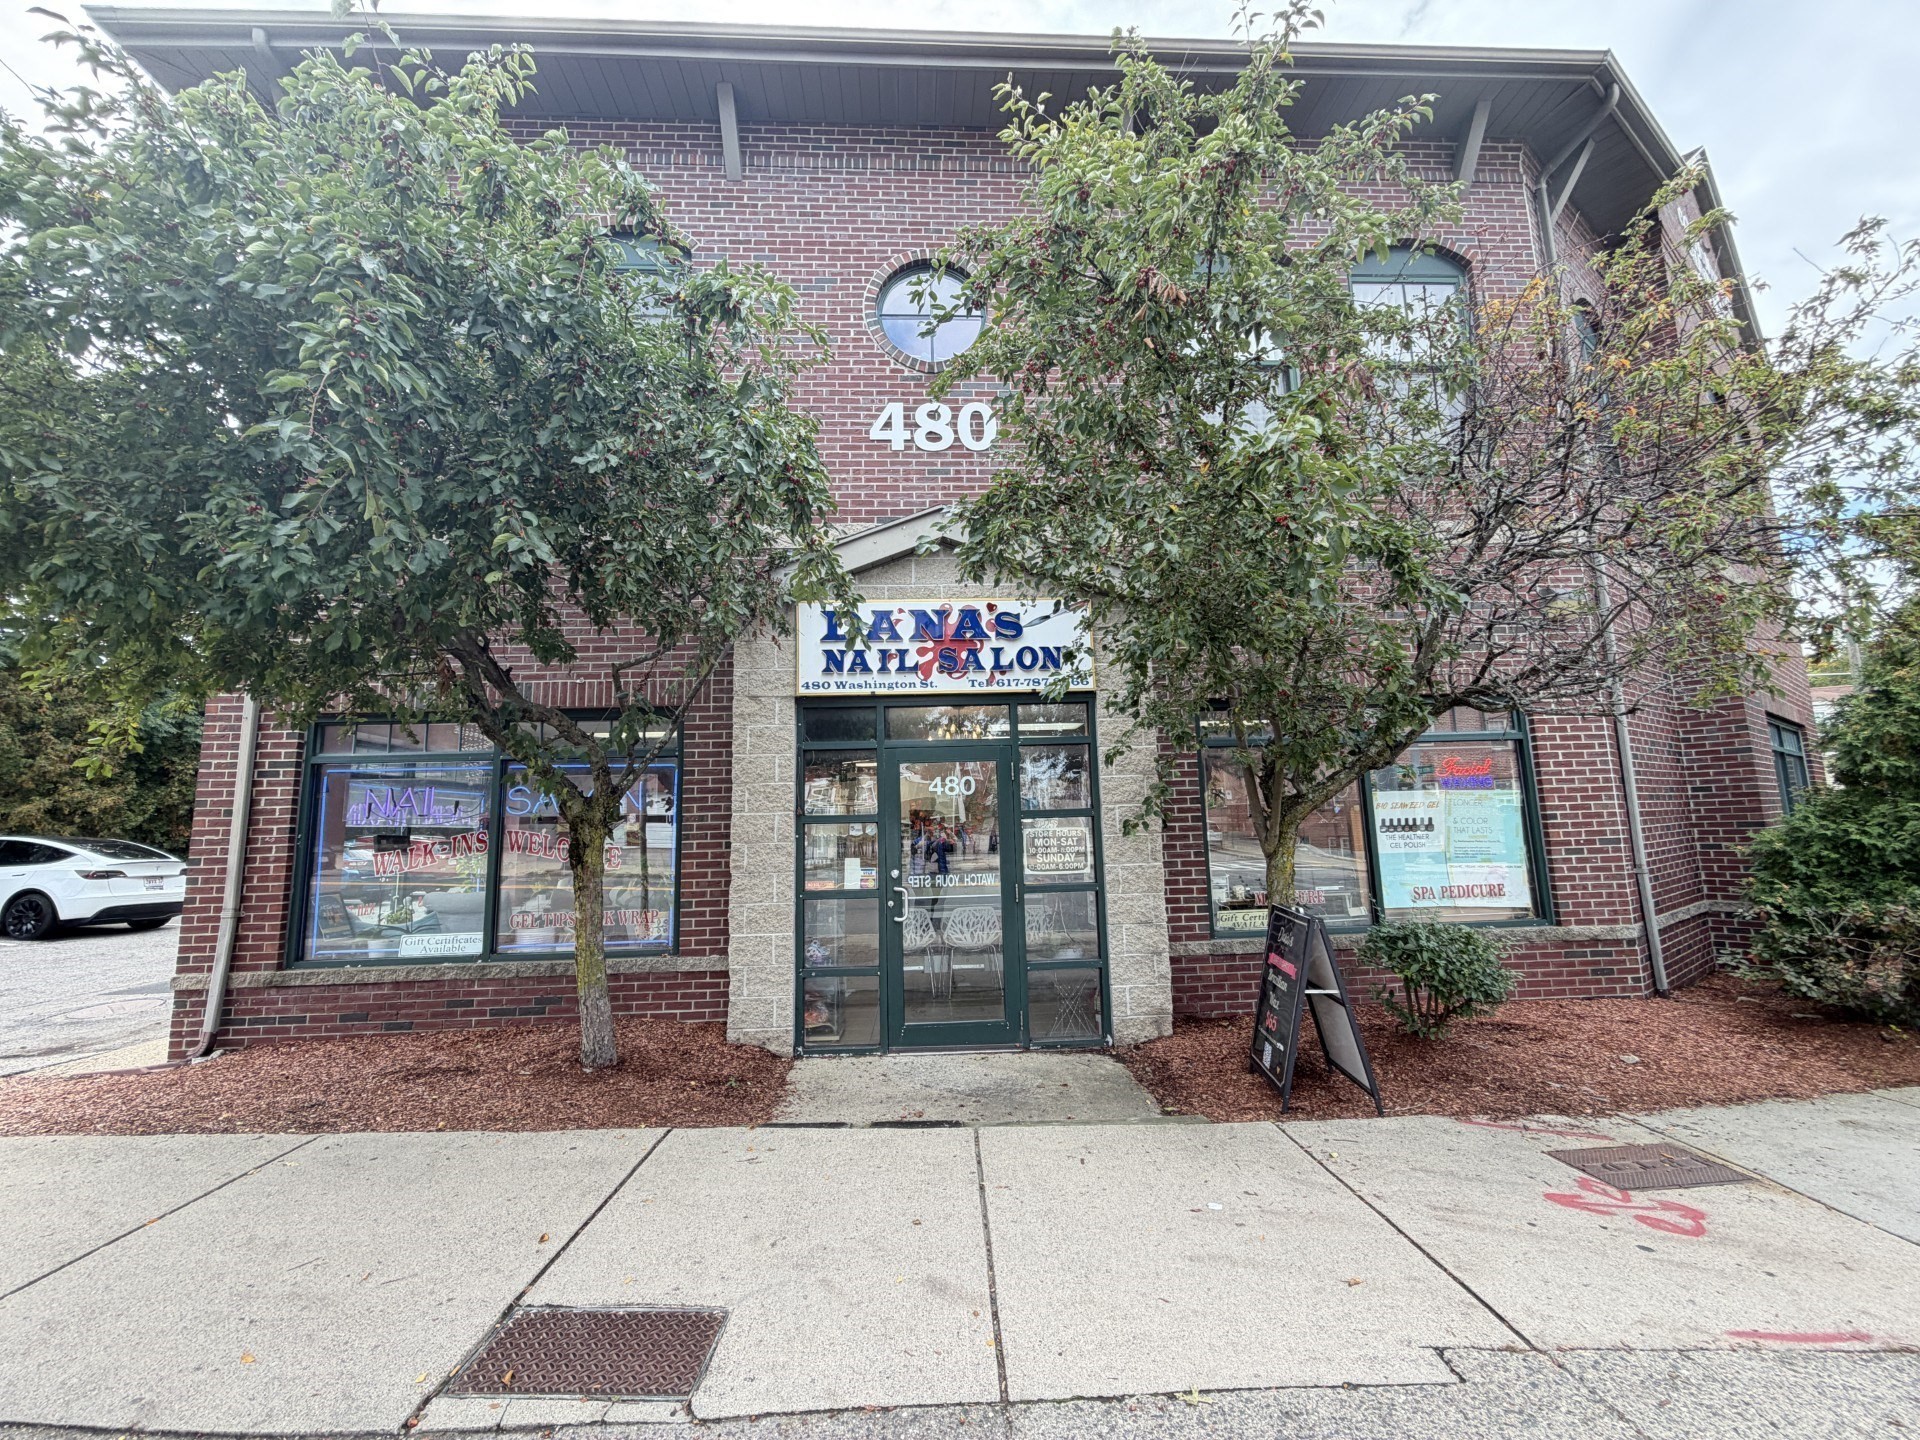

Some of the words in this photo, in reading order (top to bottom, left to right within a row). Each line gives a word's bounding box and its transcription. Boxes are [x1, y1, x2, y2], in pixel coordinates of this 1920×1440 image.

[870, 402, 997, 451] 480
[822, 648, 920, 674] NAIL
[938, 646, 1063, 672] SALON
[801, 681, 831, 690] 480
[834, 680, 916, 691] Washington
[920, 680, 938, 689] St.
[928, 775, 976, 796] 480
[366, 786, 455, 818] NAIL
[506, 781, 643, 815] SAN
[1460, 817, 1488, 825] COLOR
[1029, 830, 1053, 838] STORE
[1034, 838, 1078, 846] MON-SAT
[373, 830, 489, 877] WALK-INS
[505, 829, 621, 870] WELCE
[1036, 853, 1076, 862] SUNDAY
[1413, 886, 1436, 900] SPA
[1441, 883, 1506, 899] PEDICURE
[509, 912, 539, 929] GEL
[543, 911, 576, 928] TIPS
[617, 908, 660, 926] WRAP
[1220, 914, 1238, 922] Gift
[405, 937, 424, 946] Gift
[427, 935, 483, 945] Certificates
[420, 944, 466, 953] Available
